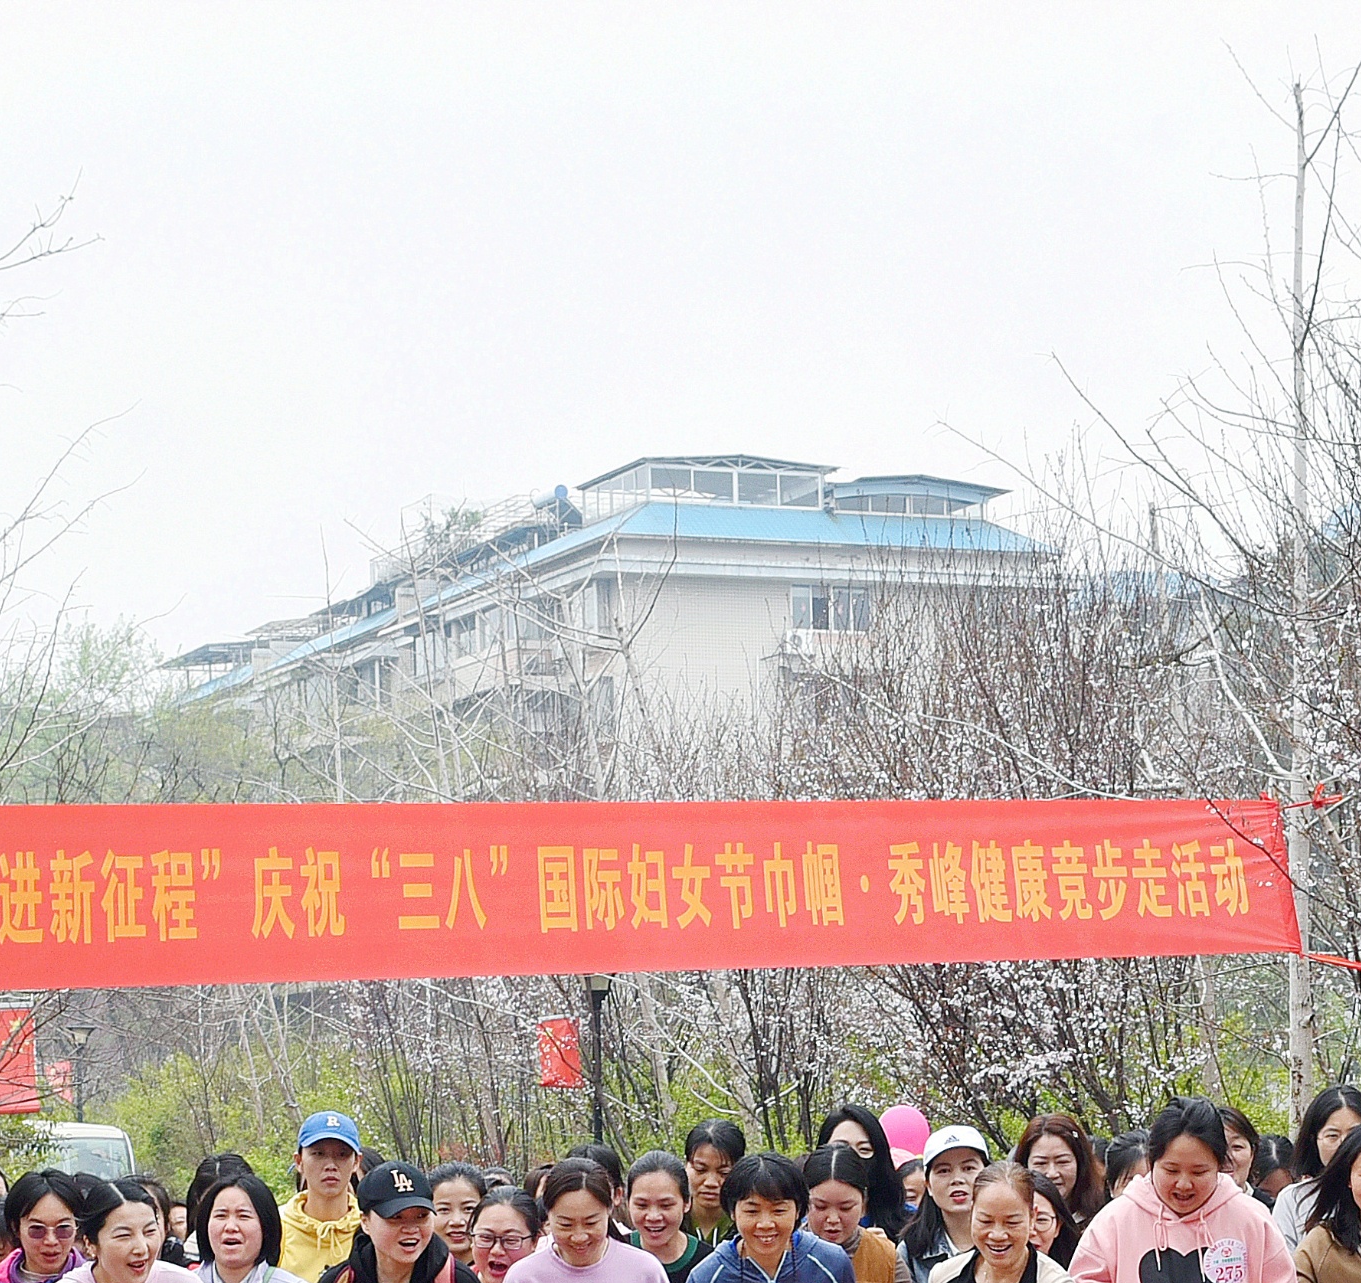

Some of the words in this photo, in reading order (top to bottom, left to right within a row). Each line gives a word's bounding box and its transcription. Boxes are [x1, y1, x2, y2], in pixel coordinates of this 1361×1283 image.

[326, 1115, 341, 1127] R
[390, 1169, 415, 1193] LA
[1215, 1265, 1243, 1283] 275
